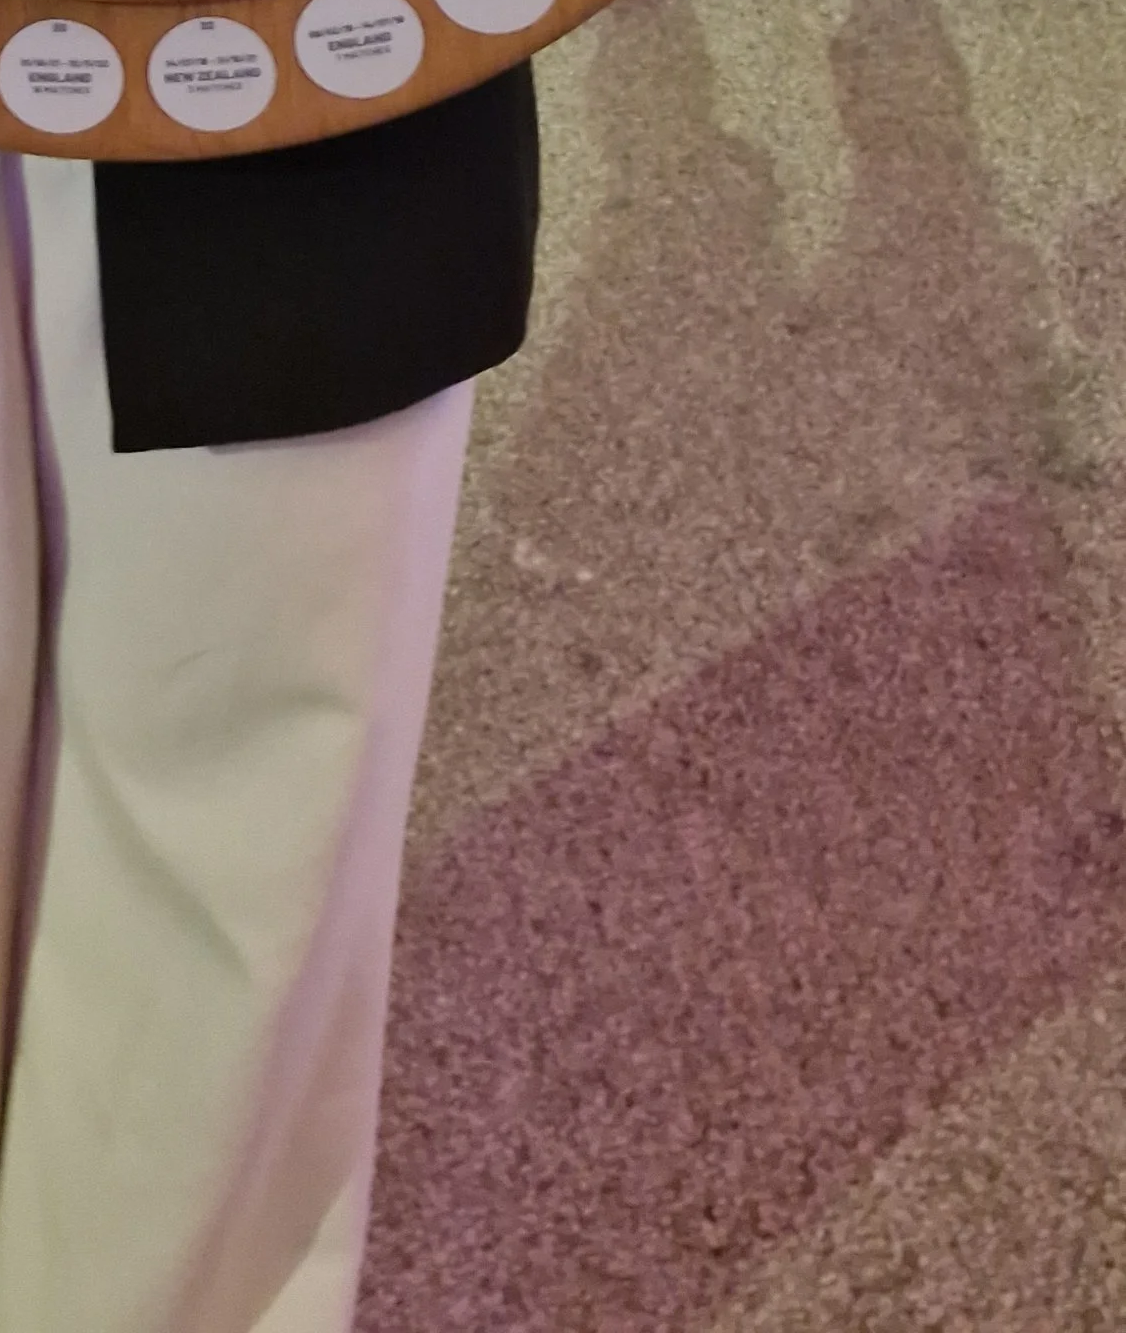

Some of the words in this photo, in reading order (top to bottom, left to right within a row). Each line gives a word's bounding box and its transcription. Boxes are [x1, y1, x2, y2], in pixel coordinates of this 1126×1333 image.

[327, 32, 393, 52] ENGLAND
[163, 71, 195, 84] NEW
[197, 66, 262, 82] ZEALAND
